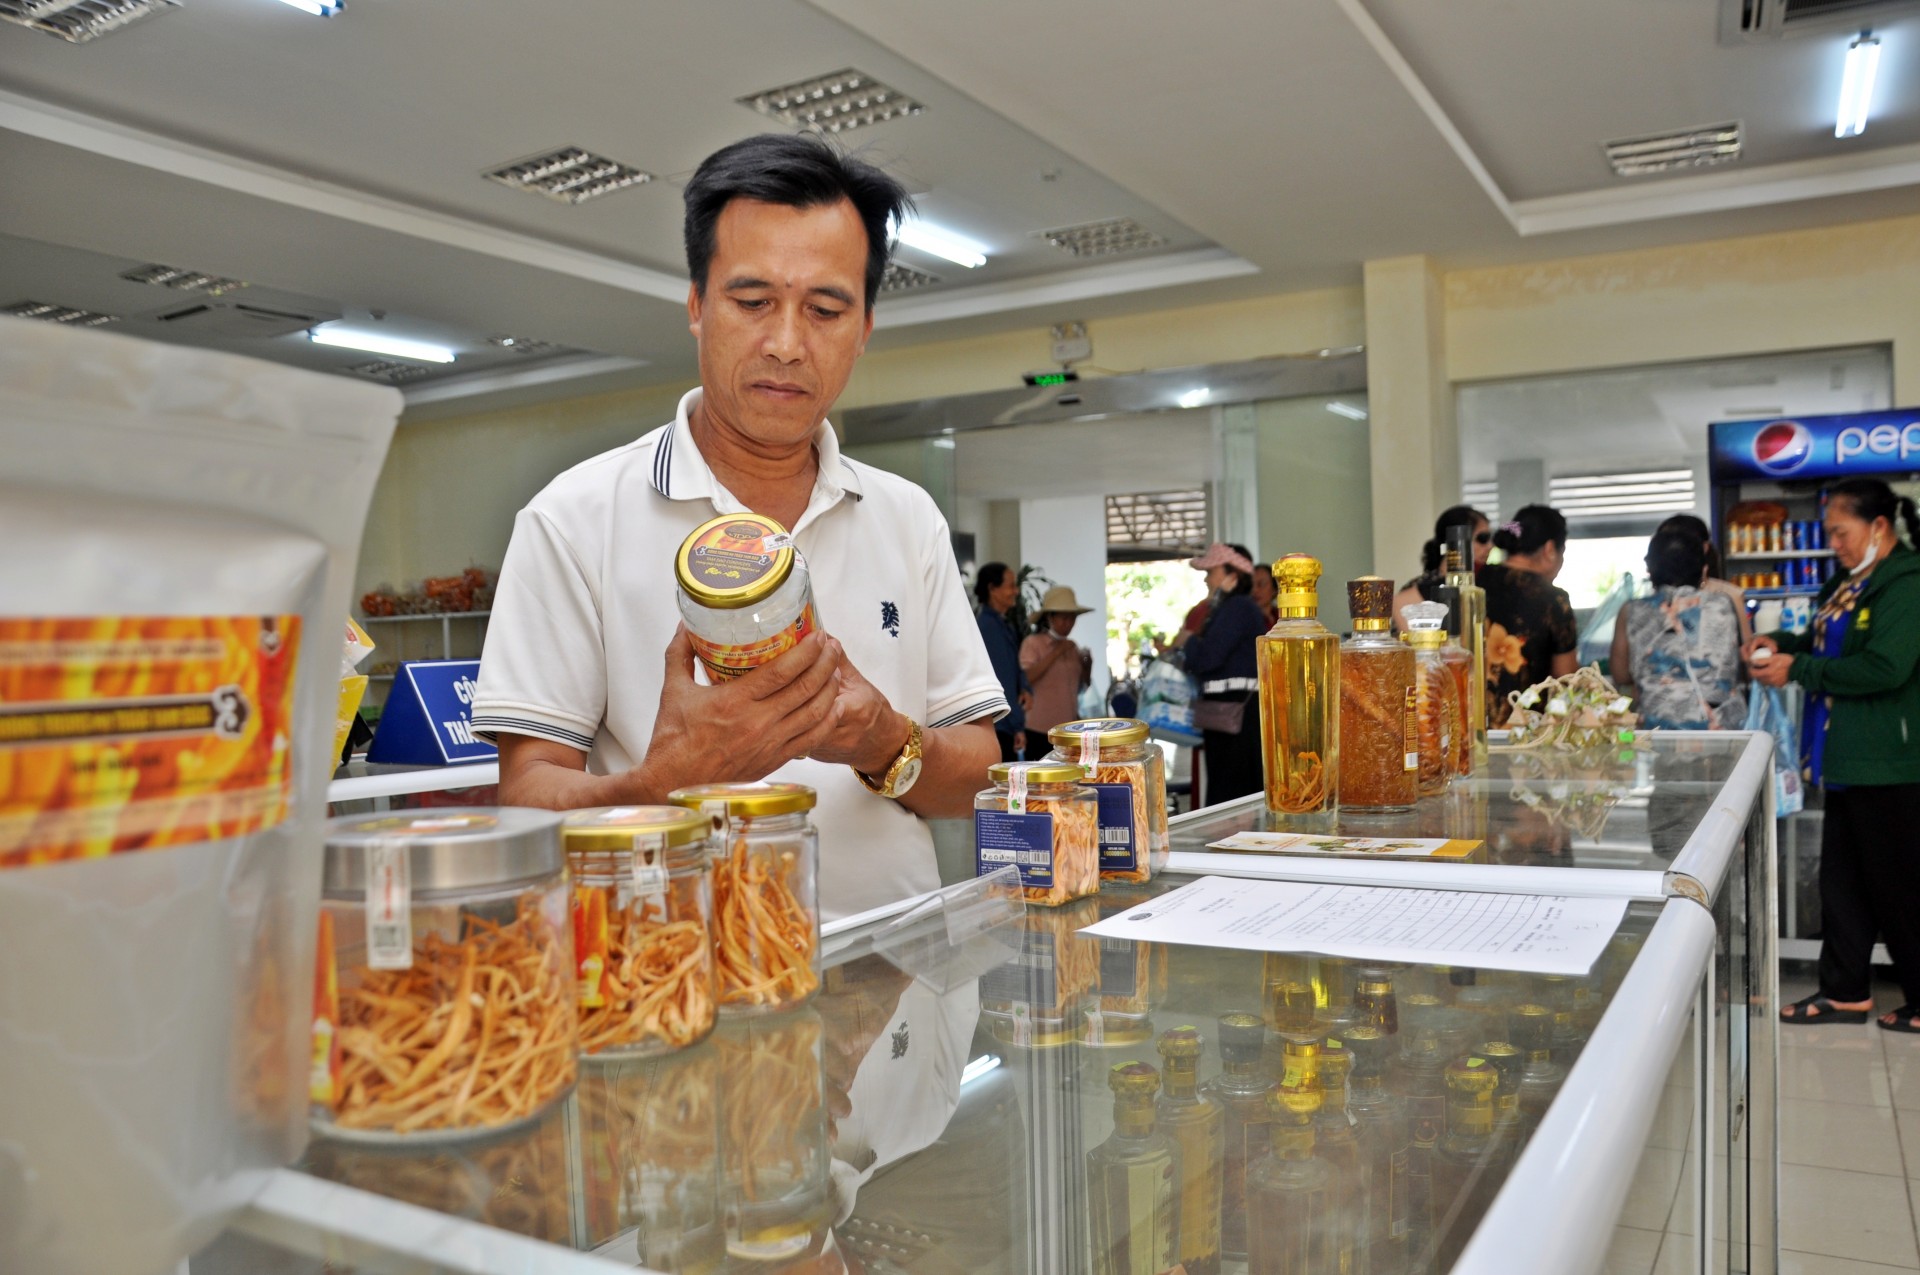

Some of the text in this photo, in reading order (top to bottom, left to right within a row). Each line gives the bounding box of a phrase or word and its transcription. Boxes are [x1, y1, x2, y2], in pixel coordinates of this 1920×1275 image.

[1836, 422, 1920, 464] pep
[453, 675, 478, 704] CÔ
[442, 711, 481, 745] THẢ
